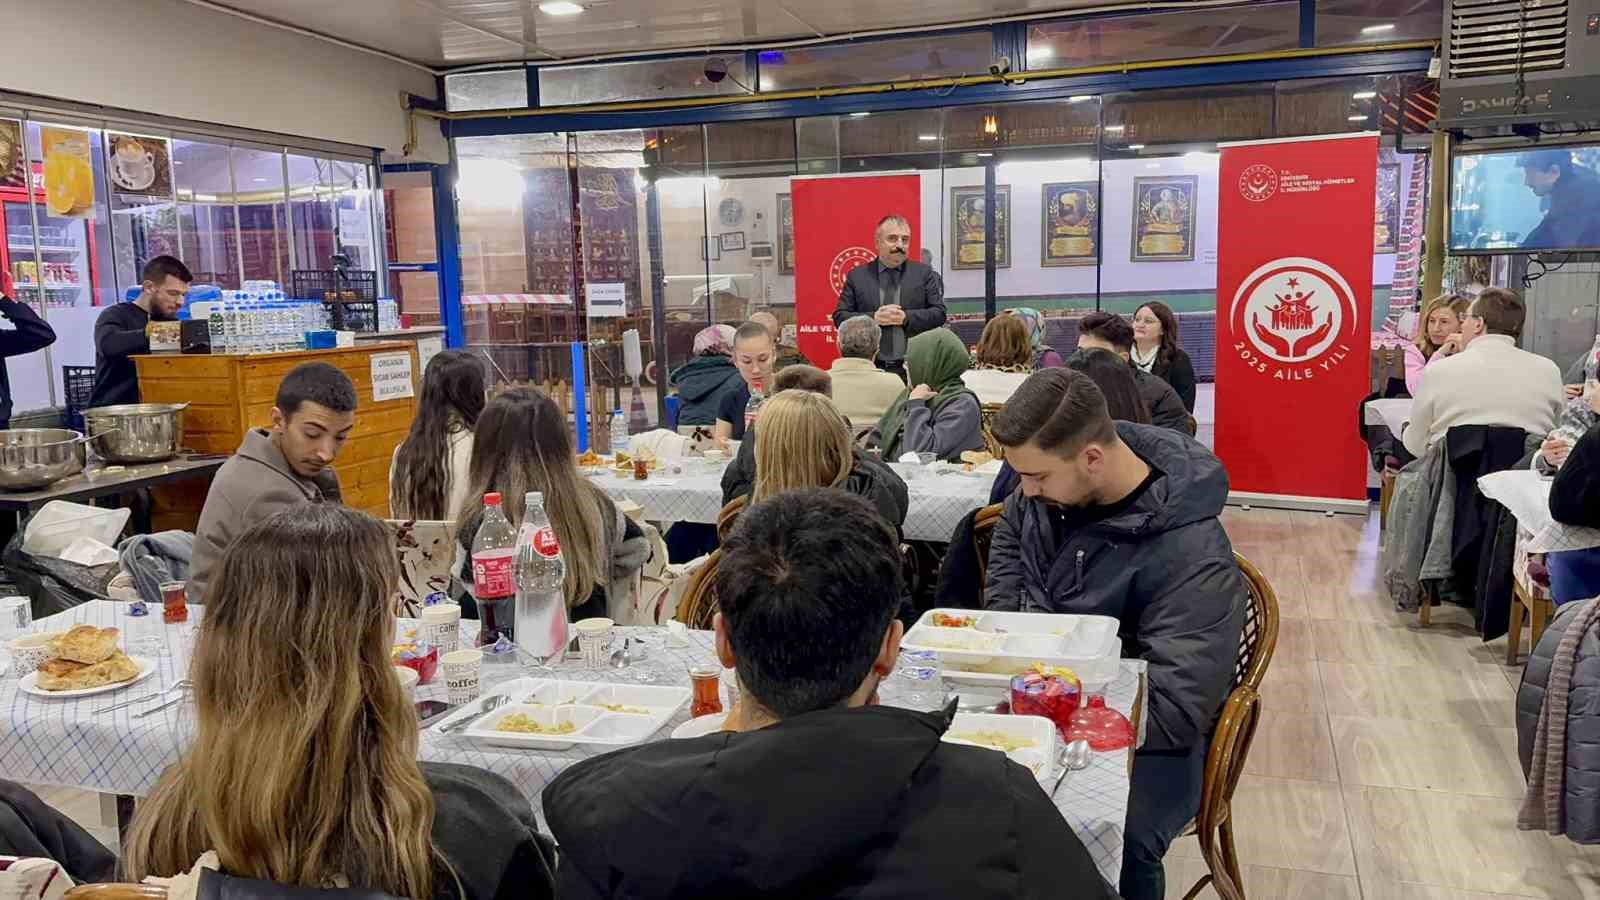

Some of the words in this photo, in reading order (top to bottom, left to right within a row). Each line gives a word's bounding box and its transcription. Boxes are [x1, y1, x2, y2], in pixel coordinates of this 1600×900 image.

[820, 324, 833, 332] VE
[1233, 341, 1268, 373] 2025
[1319, 344, 1351, 371] YILI
